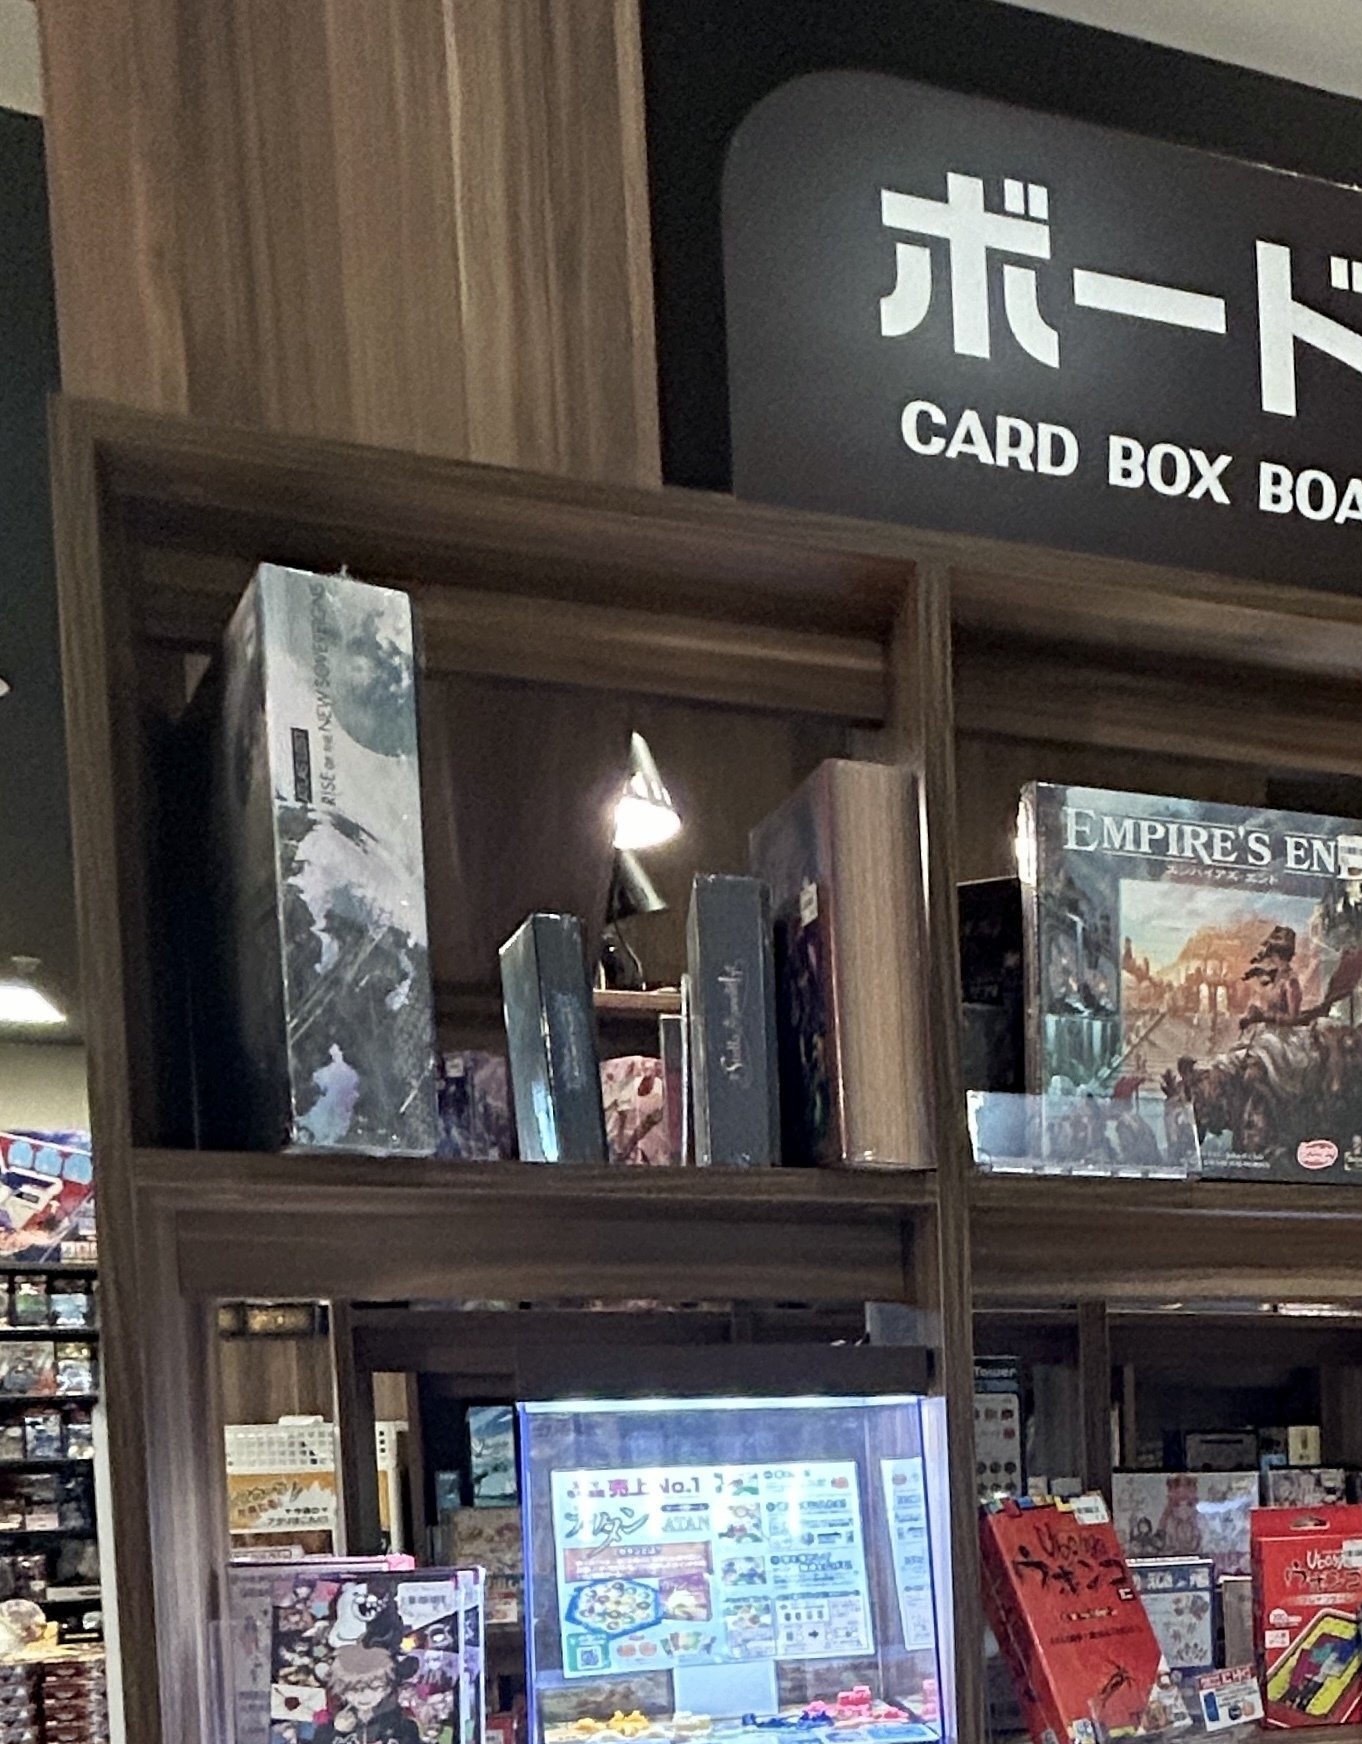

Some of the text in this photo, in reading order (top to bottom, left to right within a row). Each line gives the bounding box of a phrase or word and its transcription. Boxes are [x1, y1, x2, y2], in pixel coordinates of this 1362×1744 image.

[901, 400, 1080, 477] CARD
[1108, 434, 1233, 504] BOX
[1063, 805, 1272, 866] EMPIRE'S
